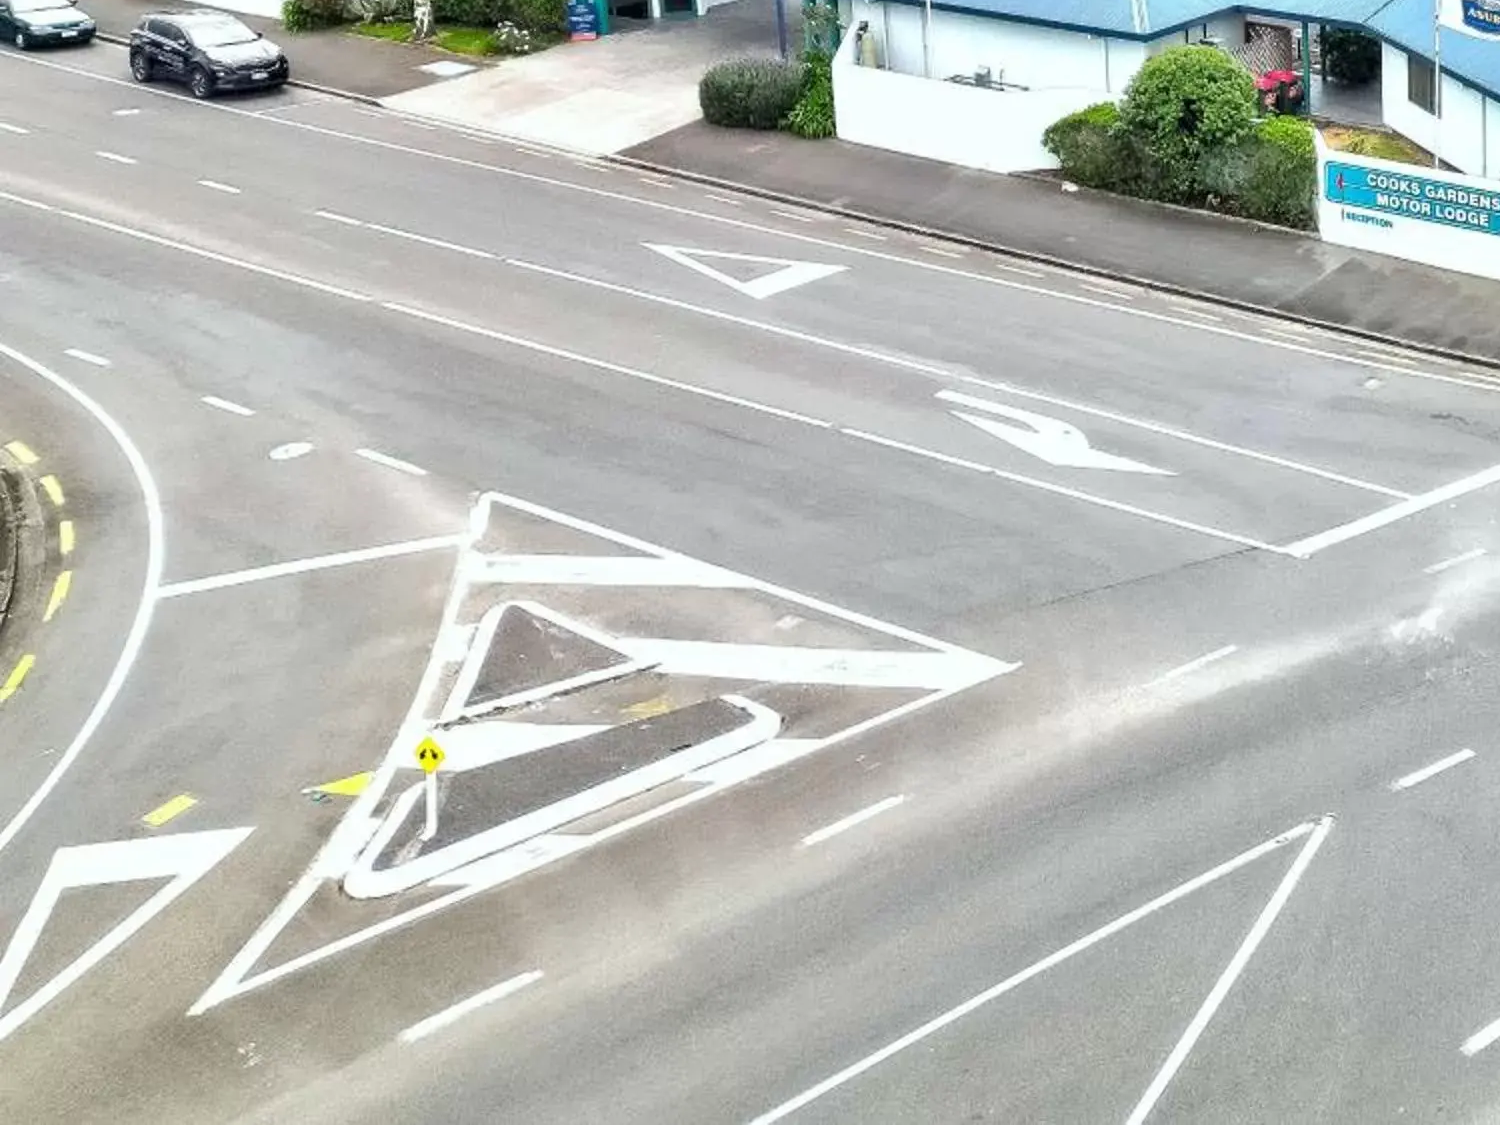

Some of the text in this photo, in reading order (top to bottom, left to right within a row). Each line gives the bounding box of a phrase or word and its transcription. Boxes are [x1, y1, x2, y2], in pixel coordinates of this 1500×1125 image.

[1366, 174, 1500, 211] COOKS GARDENS
[1376, 192, 1490, 227] MOTOR LODGE
[1346, 211, 1393, 227] RECEPTION
